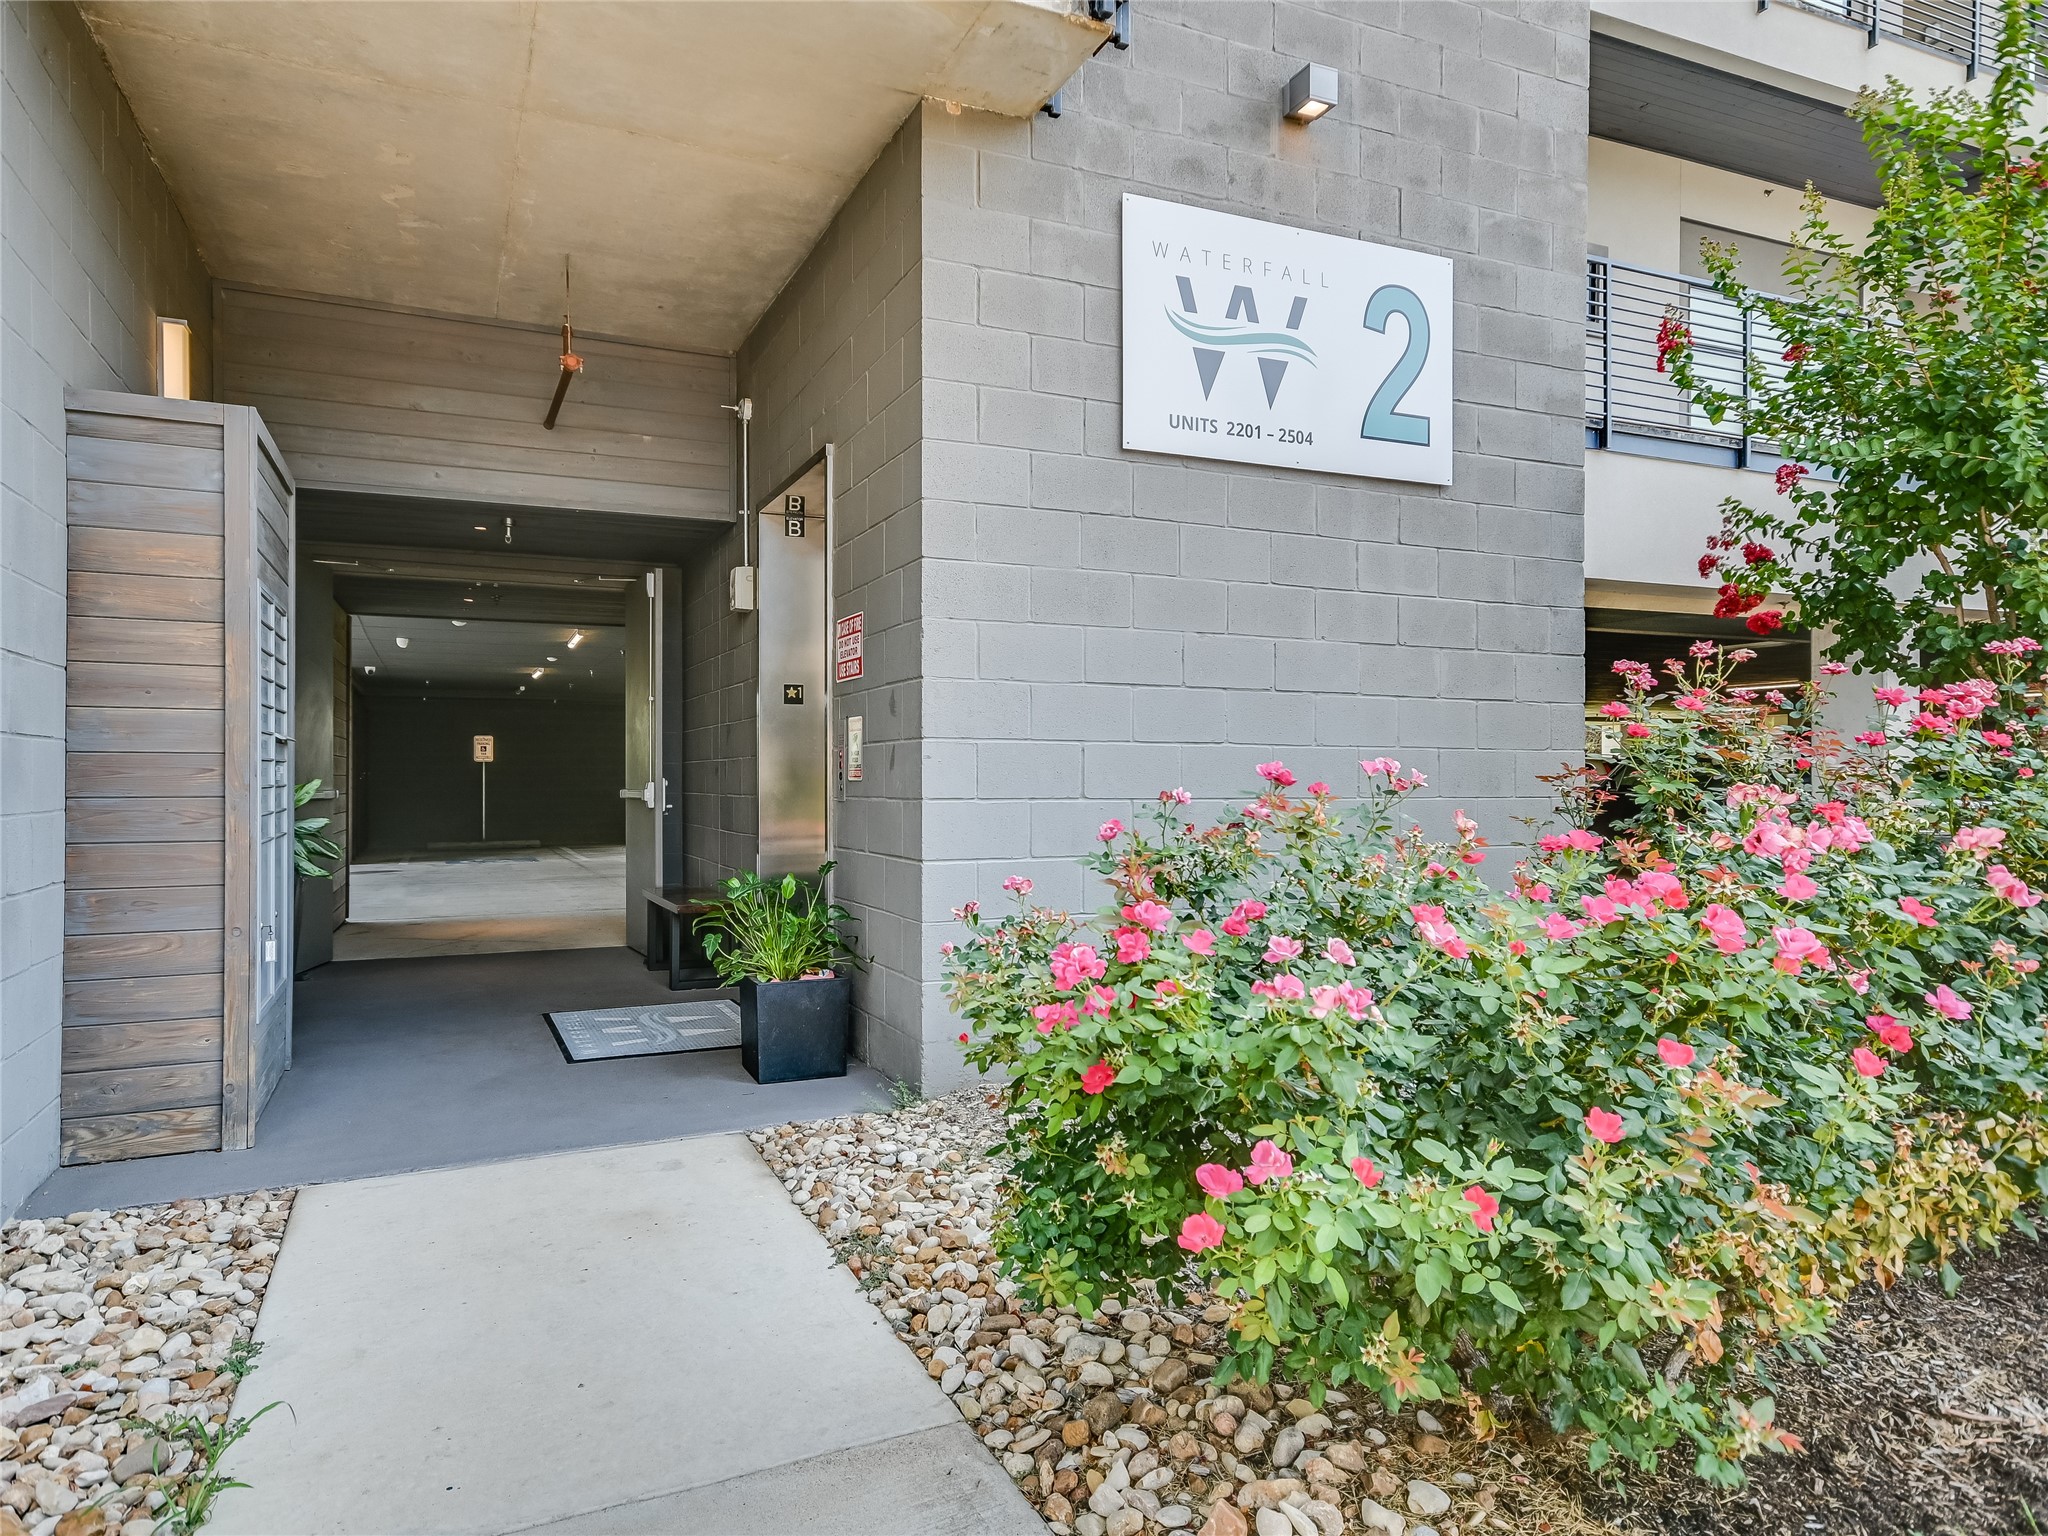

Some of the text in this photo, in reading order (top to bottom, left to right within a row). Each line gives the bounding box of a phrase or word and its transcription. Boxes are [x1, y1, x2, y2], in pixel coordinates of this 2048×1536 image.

[1152, 240, 1329, 288] WATERFALL
[1360, 283, 1431, 447] 2
[1168, 413, 1218, 434] UNITS
[1226, 421, 1262, 440] 2201
[1278, 427, 1314, 446] 2504
[789, 520, 801, 536] B
[838, 634, 860, 650] DO NOT USE
[840, 646, 858, 660] ELEVATOR
